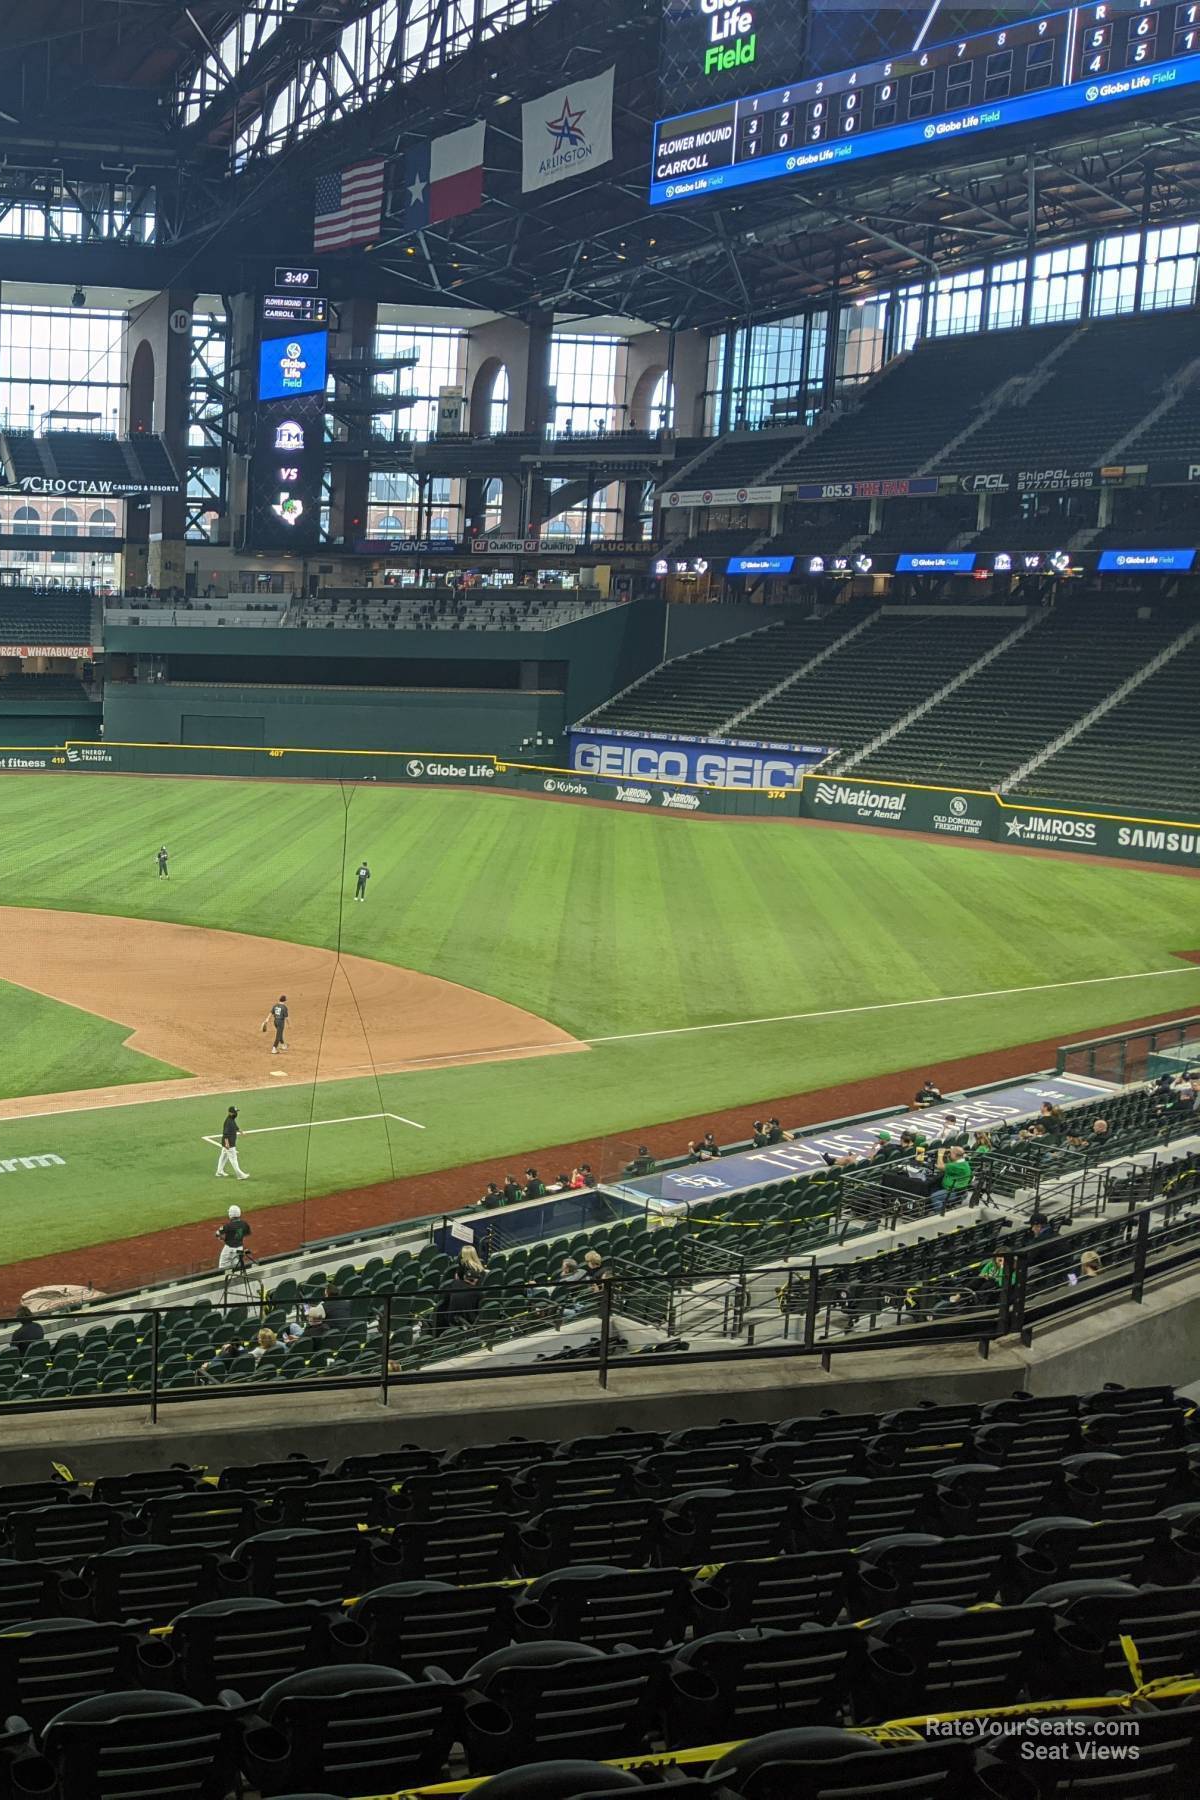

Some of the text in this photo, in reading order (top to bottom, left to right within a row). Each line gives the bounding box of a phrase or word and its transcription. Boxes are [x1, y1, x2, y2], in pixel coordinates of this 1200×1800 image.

[711, 7, 752, 42] Life
[705, 34, 755, 75] Field
[752, 6, 1106, 110] 1 2 3 4 5 6 7 8 9 R
[658, 7, 1196, 157] FLOWER MOUND 3 2 0 0 0 5 6 1
[1100, 70, 1175, 97] Globe Life Field
[657, 33, 1193, 178] CARROLL 1 0 3 0 4 5 1
[937, 111, 1000, 134] Globe Life Field
[539, 144, 592, 174] ARLINGTON
[797, 145, 851, 166] Globe Life Field
[675, 183, 693, 194] Globe
[284, 271, 309, 284] 3:49
[265, 310, 294, 318] CARROLL
[173, 314, 188, 329] 10
[280, 359, 306, 369] Globe
[284, 368, 301, 378] Life
[282, 378, 302, 388] Field
[281, 468, 298, 479] VS
[29, 476, 112, 493] CHOCTAW
[973, 474, 1009, 489] PGL
[822, 484, 853, 498] 105.3
[389, 541, 428, 552] SIGNS
[474, 541, 574, 552] QT QuikTrip QT QuikTrip
[676, 562, 688, 571] VS
[835, 559, 847, 569] VS
[1025, 556, 1039, 567] VS
[27, 646, 88, 657] WHATABURGER
[8, 757, 45, 769] fitness
[574, 744, 687, 783] GEICO
[427, 763, 494, 778] Globe Life
[557, 782, 588, 795] Kubota
[768, 791, 785, 799] 374
[857, 808, 901, 820] Car Rental
[933, 815, 982, 827] OLD DOMINION
[935, 822, 980, 834] FREIGHT LINE
[1022, 831, 1058, 842] LAW GROUP
